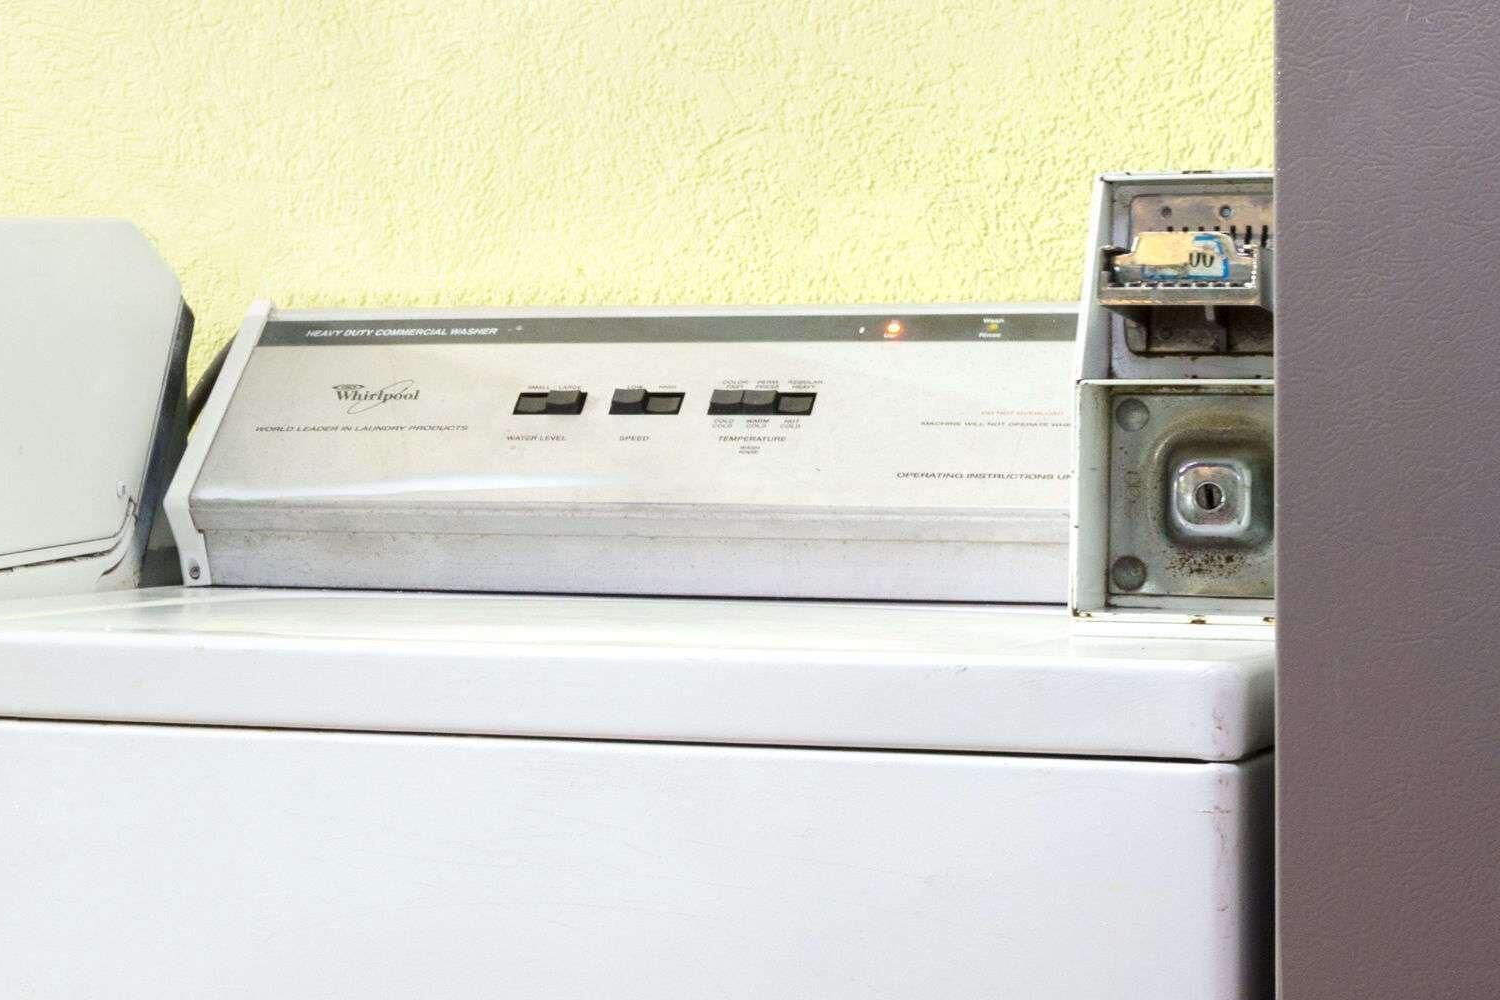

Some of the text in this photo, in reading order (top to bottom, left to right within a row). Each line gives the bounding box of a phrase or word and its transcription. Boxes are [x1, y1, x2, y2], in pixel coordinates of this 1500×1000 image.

[304, 326, 500, 338] HEAVY DUTY COMMERCIAL WASHER
[335, 386, 421, 406] Whirlpool
[254, 424, 469, 432] WORLD LEADER IN LAUNDRY PRODUCTS
[619, 434, 650, 442] SPEED
[896, 471, 963, 480] OPERATING
[966, 471, 1054, 480] INSTRUCTIONS
